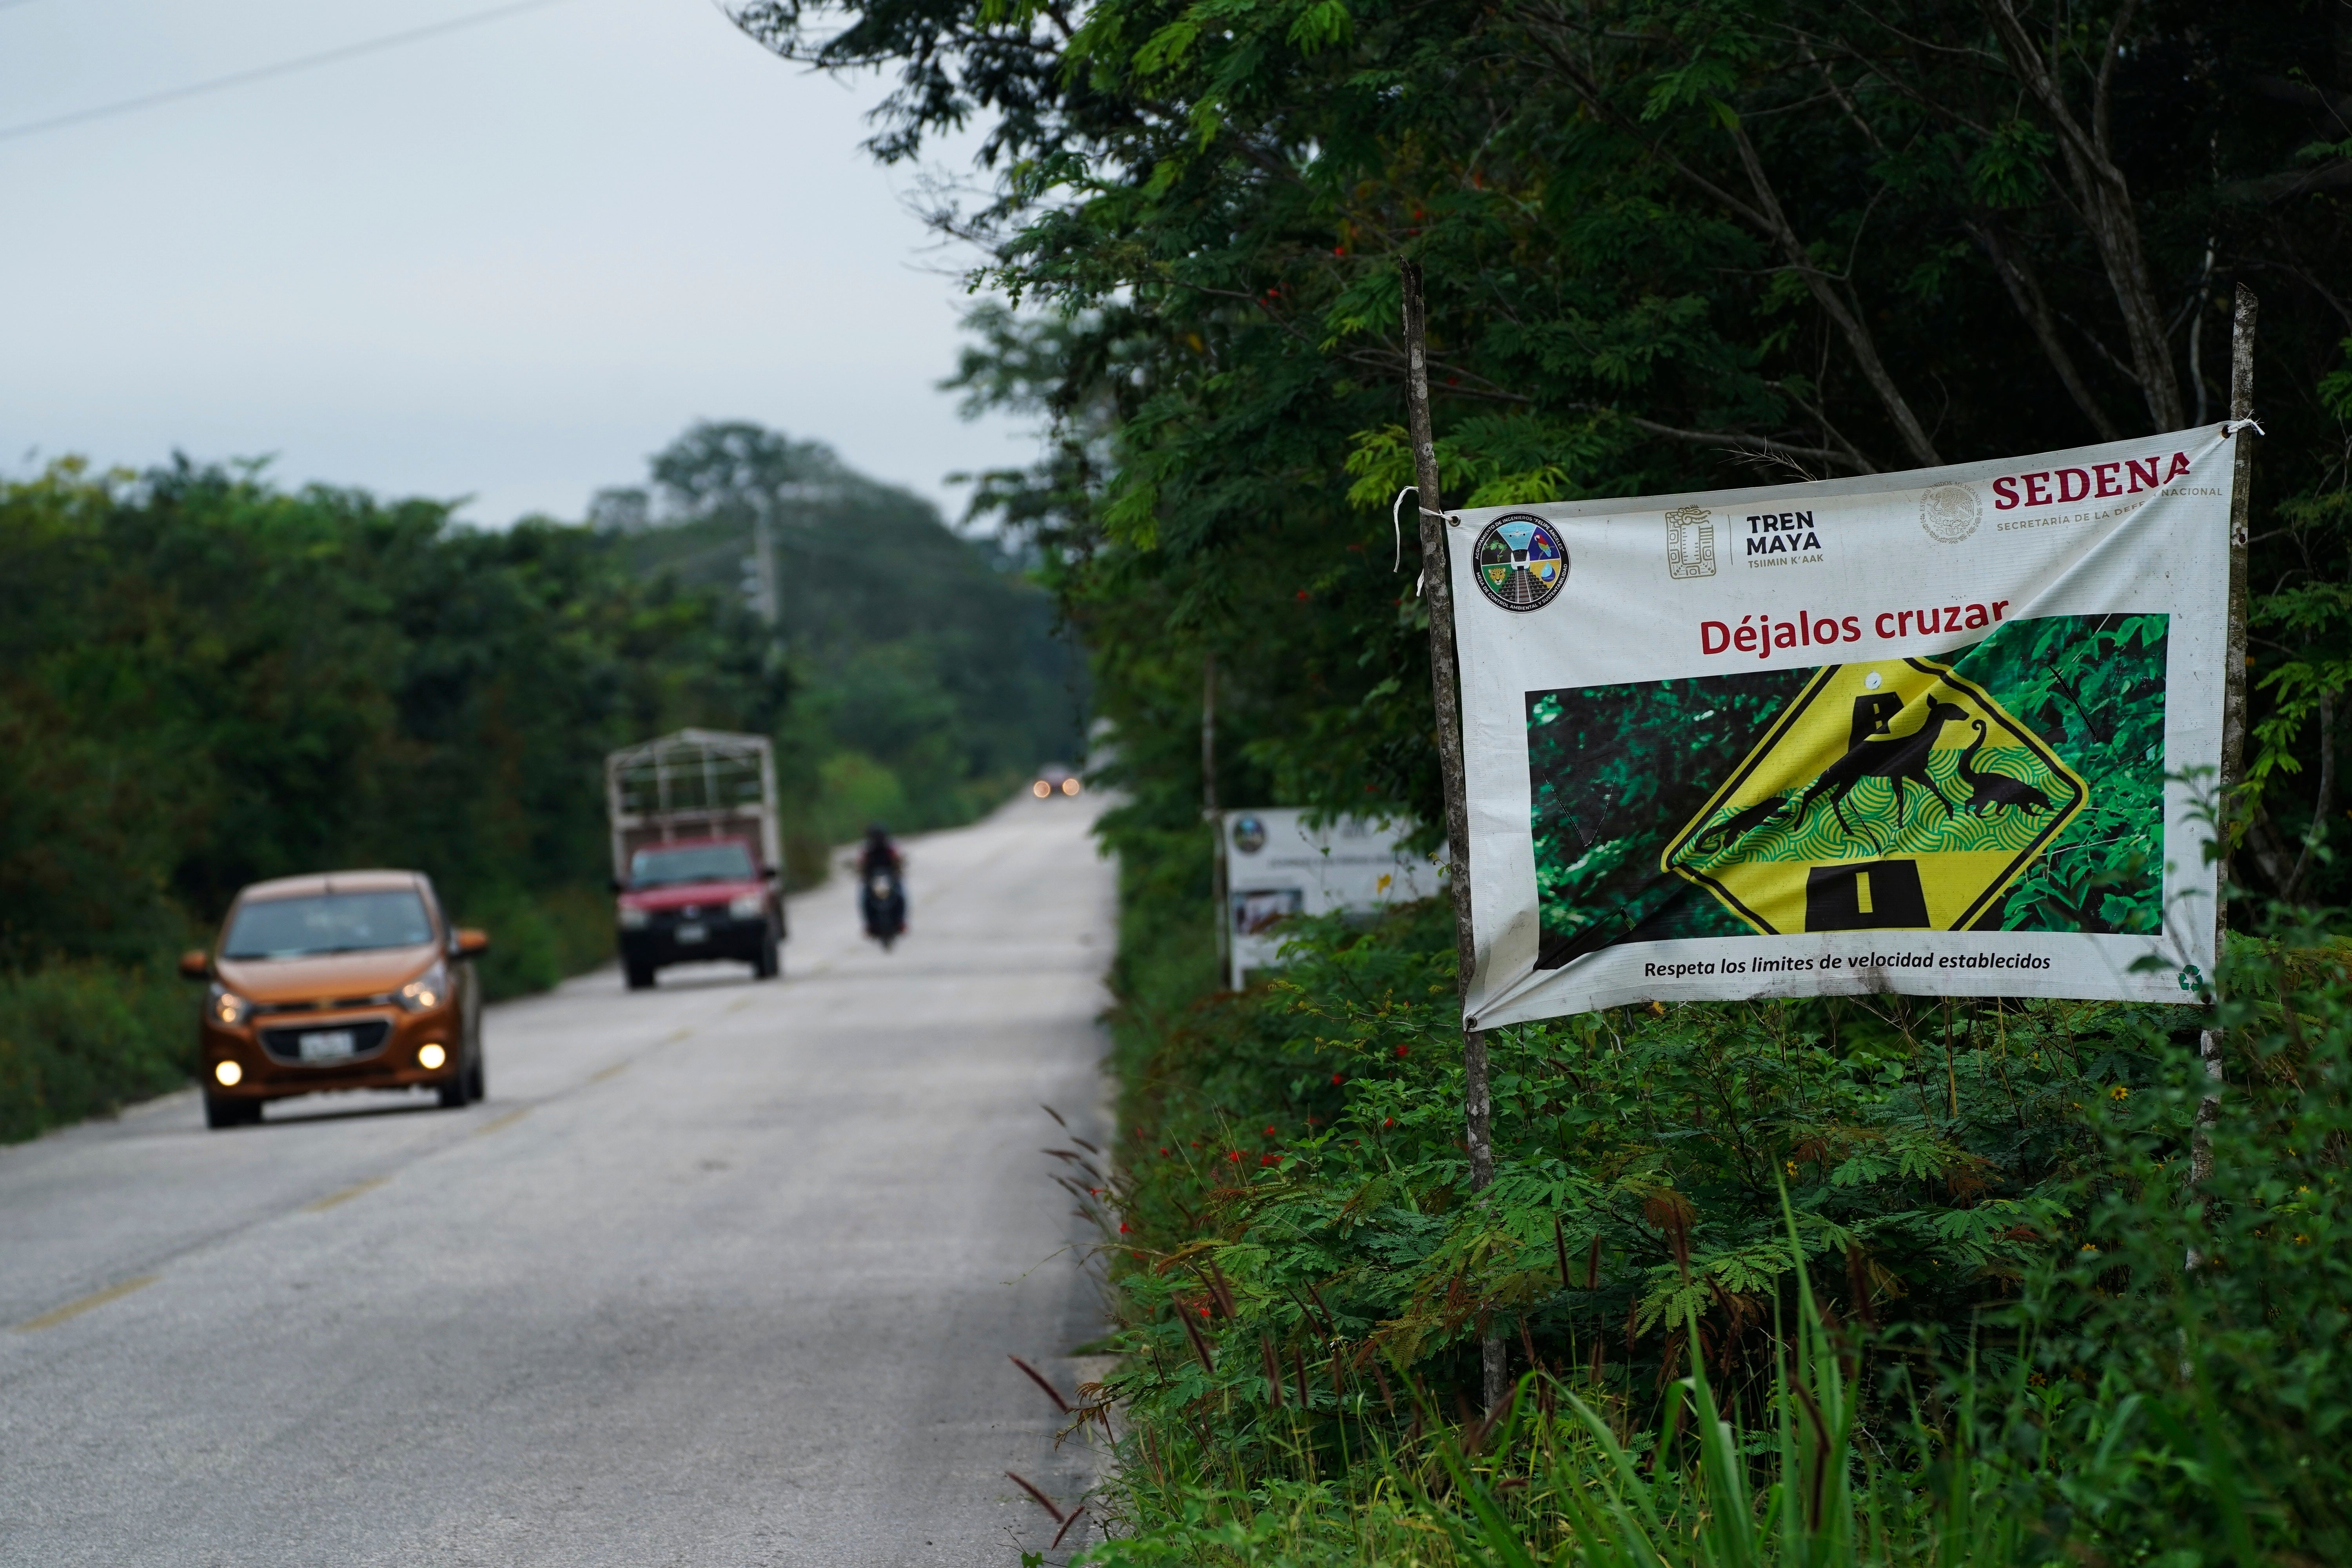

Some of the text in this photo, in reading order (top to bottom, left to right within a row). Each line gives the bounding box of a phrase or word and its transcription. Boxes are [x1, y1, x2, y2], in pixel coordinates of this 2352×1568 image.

[1920, 481, 1982, 511] ESTADOS UNIDOS MEXICANOS
[1993, 452, 2190, 510] SEDENA
[1746, 511, 1814, 534] TREN
[1997, 515, 2070, 531] SECRETARÍA
[2075, 513, 2090, 522] DE
[2095, 511, 2110, 520] LA
[2161, 488, 2223, 496] NACIONAL
[1475, 524, 1495, 560] AGRUPAMIENTO
[1746, 532, 1821, 555] MAYA
[1748, 557, 1788, 569] TSIIMIN
[1476, 572, 1484, 587] MESA
[1488, 592, 1509, 608] CONTROL
[1542, 564, 1568, 604] SUSTENTABILIDAD
[1701, 601, 2009, 659] Déjalos cruzar
[1645, 961, 1715, 978] Respeta
[1721, 958, 1746, 974] los
[1820, 954, 1842, 969] de
[1848, 952, 1934, 967] velocidad
[1939, 953, 2050, 969] establecidos
